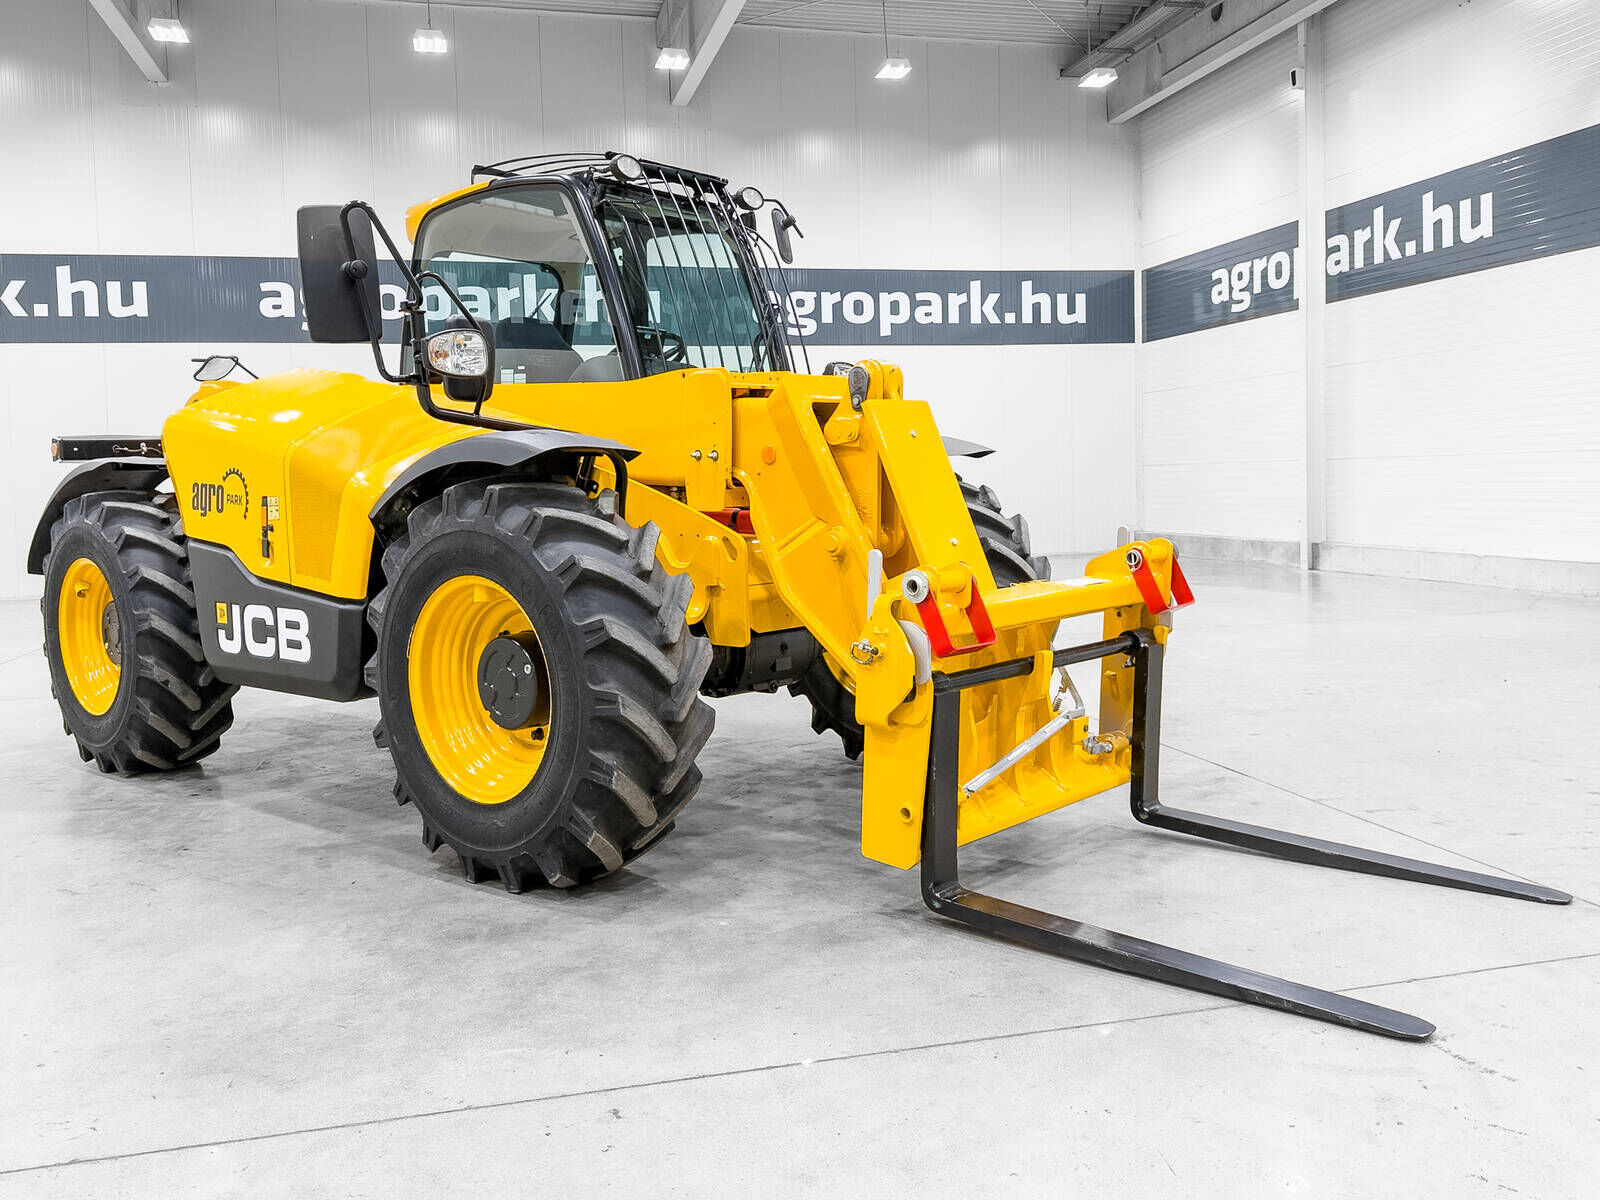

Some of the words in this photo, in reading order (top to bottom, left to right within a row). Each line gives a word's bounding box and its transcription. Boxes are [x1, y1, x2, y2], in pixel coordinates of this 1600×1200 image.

[1211, 190, 1494, 313] agroark.hu
[192, 482, 224, 517] agro
[226, 493, 243, 506] PARK
[217, 604, 311, 663] JCB
